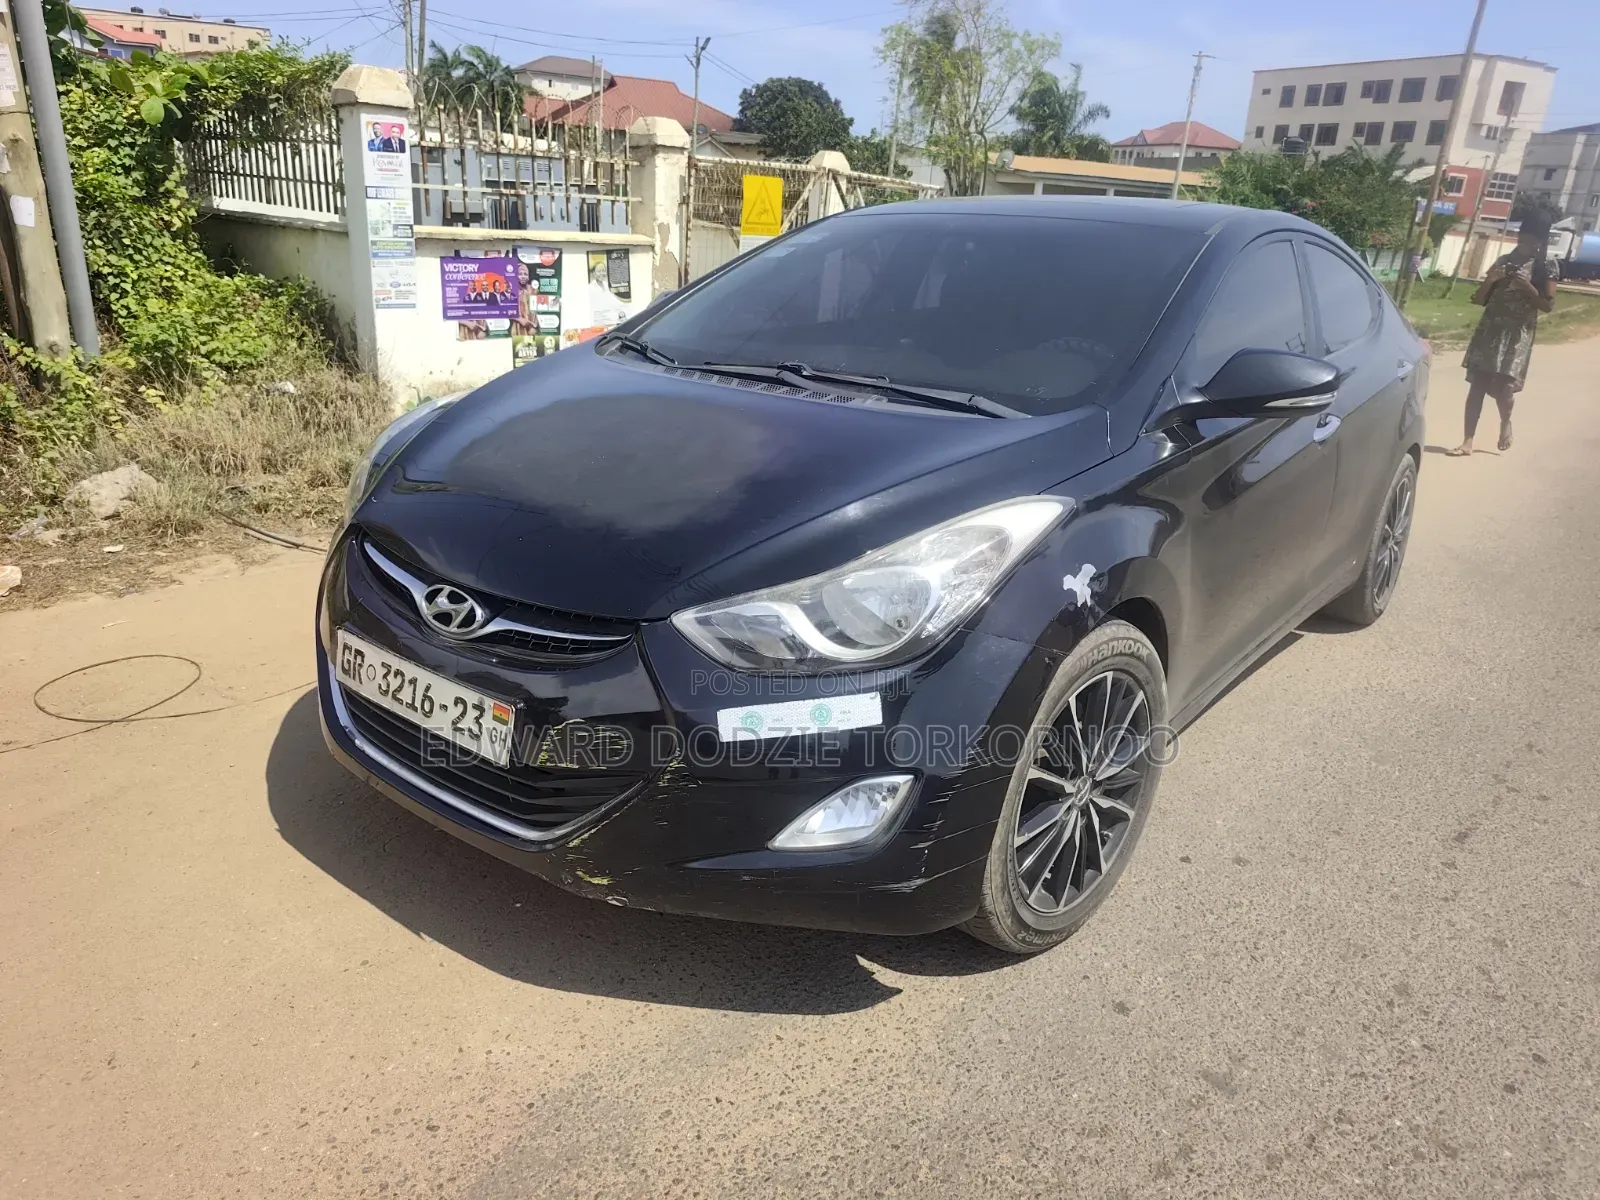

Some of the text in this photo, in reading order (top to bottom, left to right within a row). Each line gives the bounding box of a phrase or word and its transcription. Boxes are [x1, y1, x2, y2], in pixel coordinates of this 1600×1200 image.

[443, 263, 480, 272] VICTORY
[445, 271, 486, 282] conference
[341, 642, 486, 741] GR 3216-23
[489, 726, 508, 747] GH
